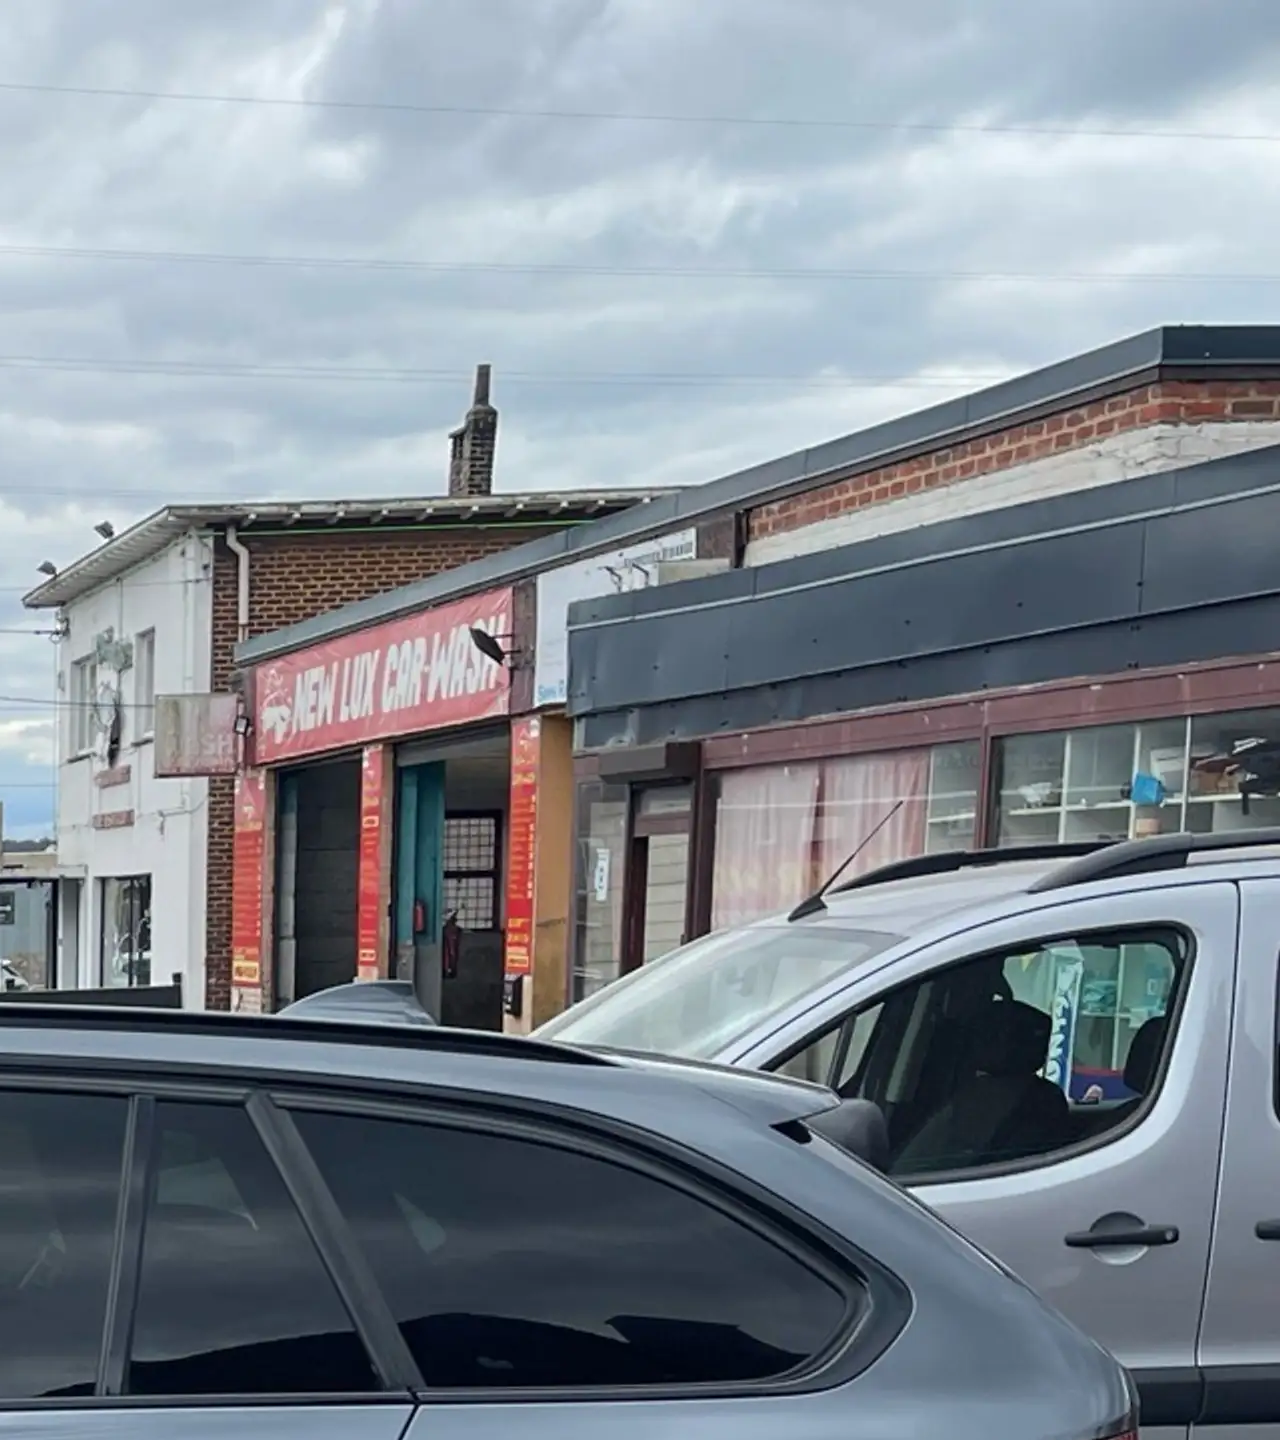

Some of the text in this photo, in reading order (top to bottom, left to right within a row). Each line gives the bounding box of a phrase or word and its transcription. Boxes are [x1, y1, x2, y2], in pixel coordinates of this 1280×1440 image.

[292, 612, 506, 735] NEW LUX CAR-WASH
